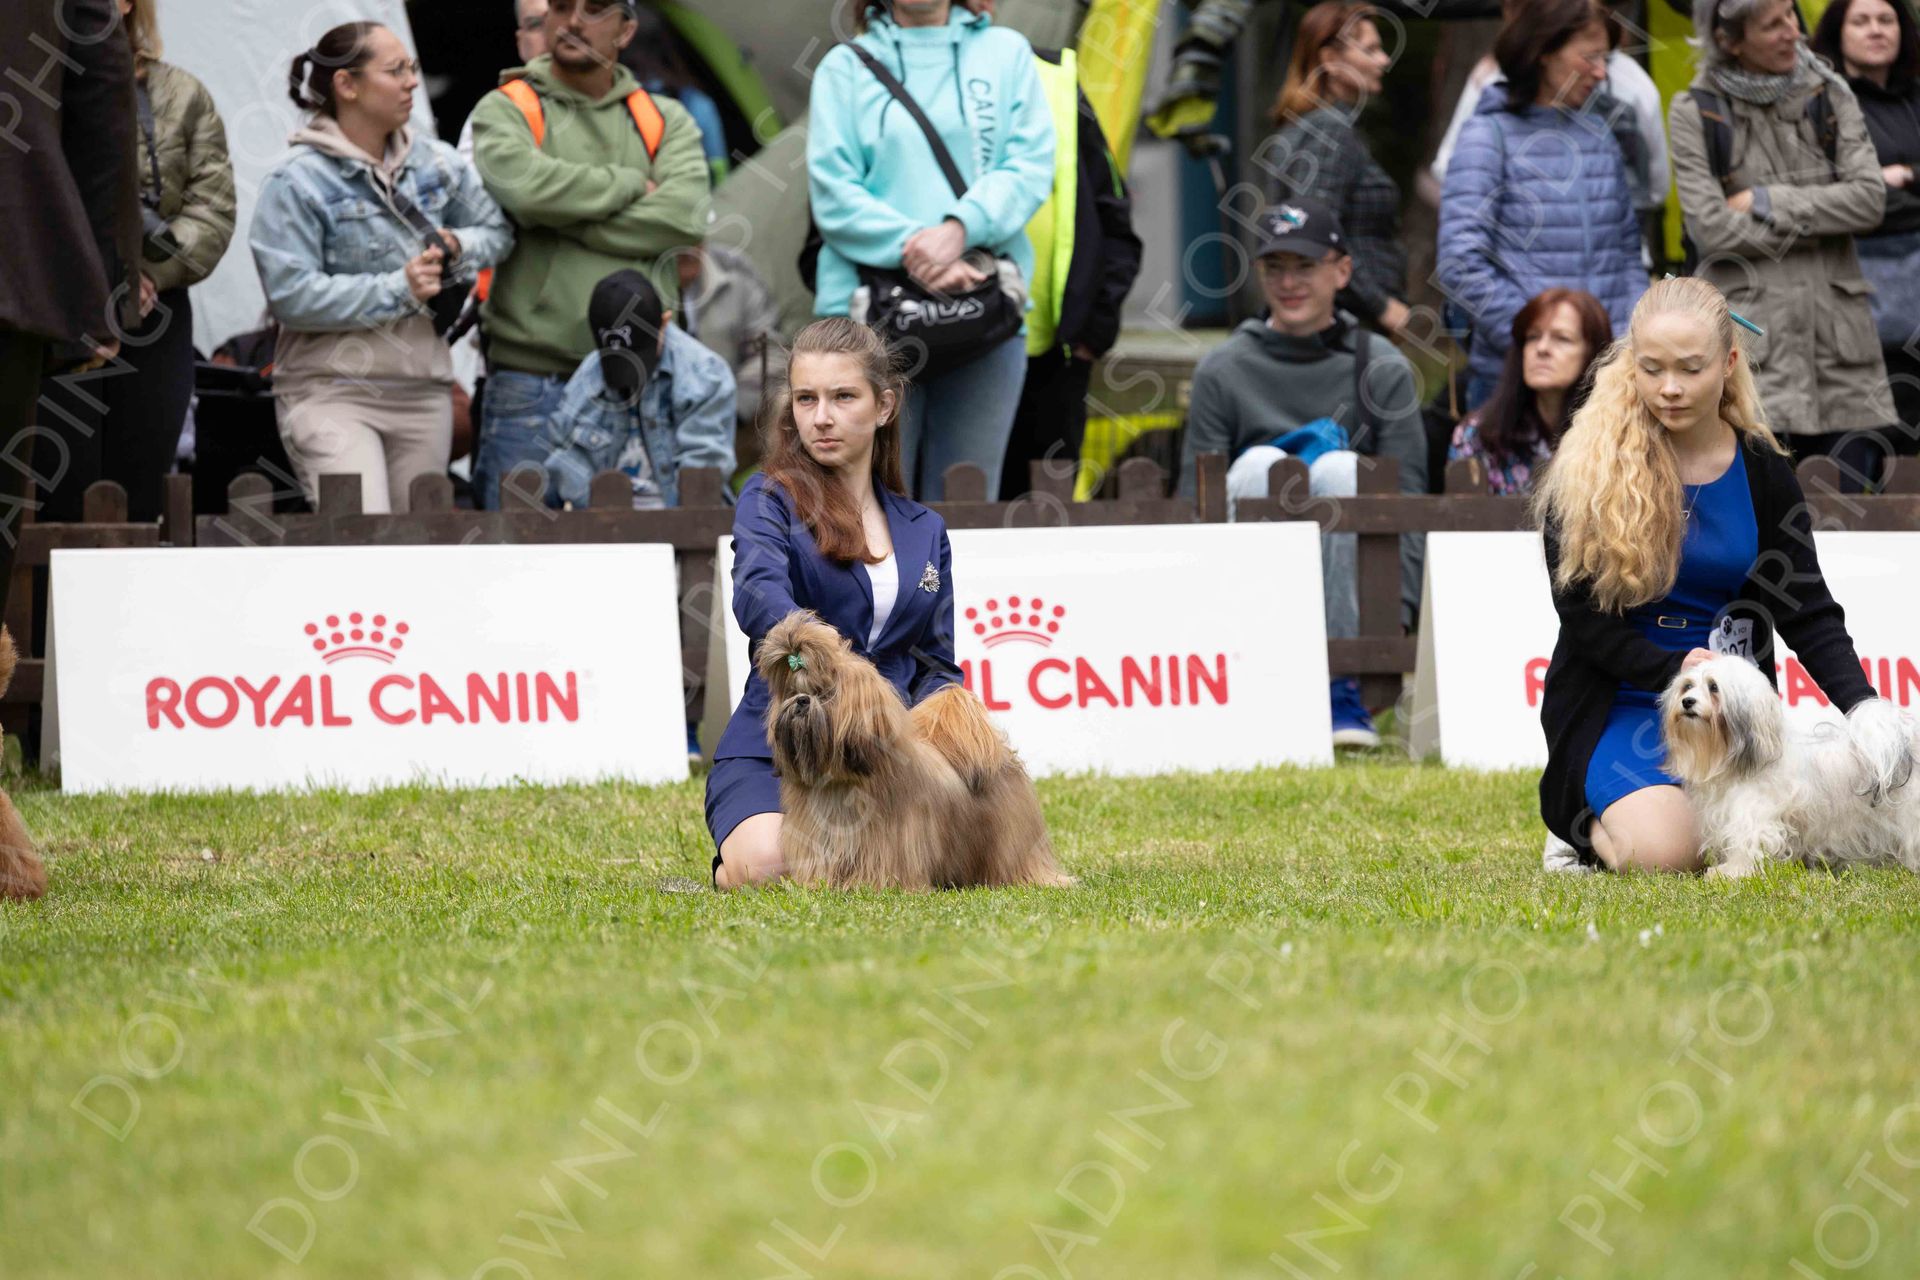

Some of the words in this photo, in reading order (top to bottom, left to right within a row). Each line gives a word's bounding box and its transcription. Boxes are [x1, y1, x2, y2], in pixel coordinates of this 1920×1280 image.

[145, 673, 353, 729] ROYAL
[368, 670, 579, 726] CANIN
[1027, 653, 1229, 710] CANIN
